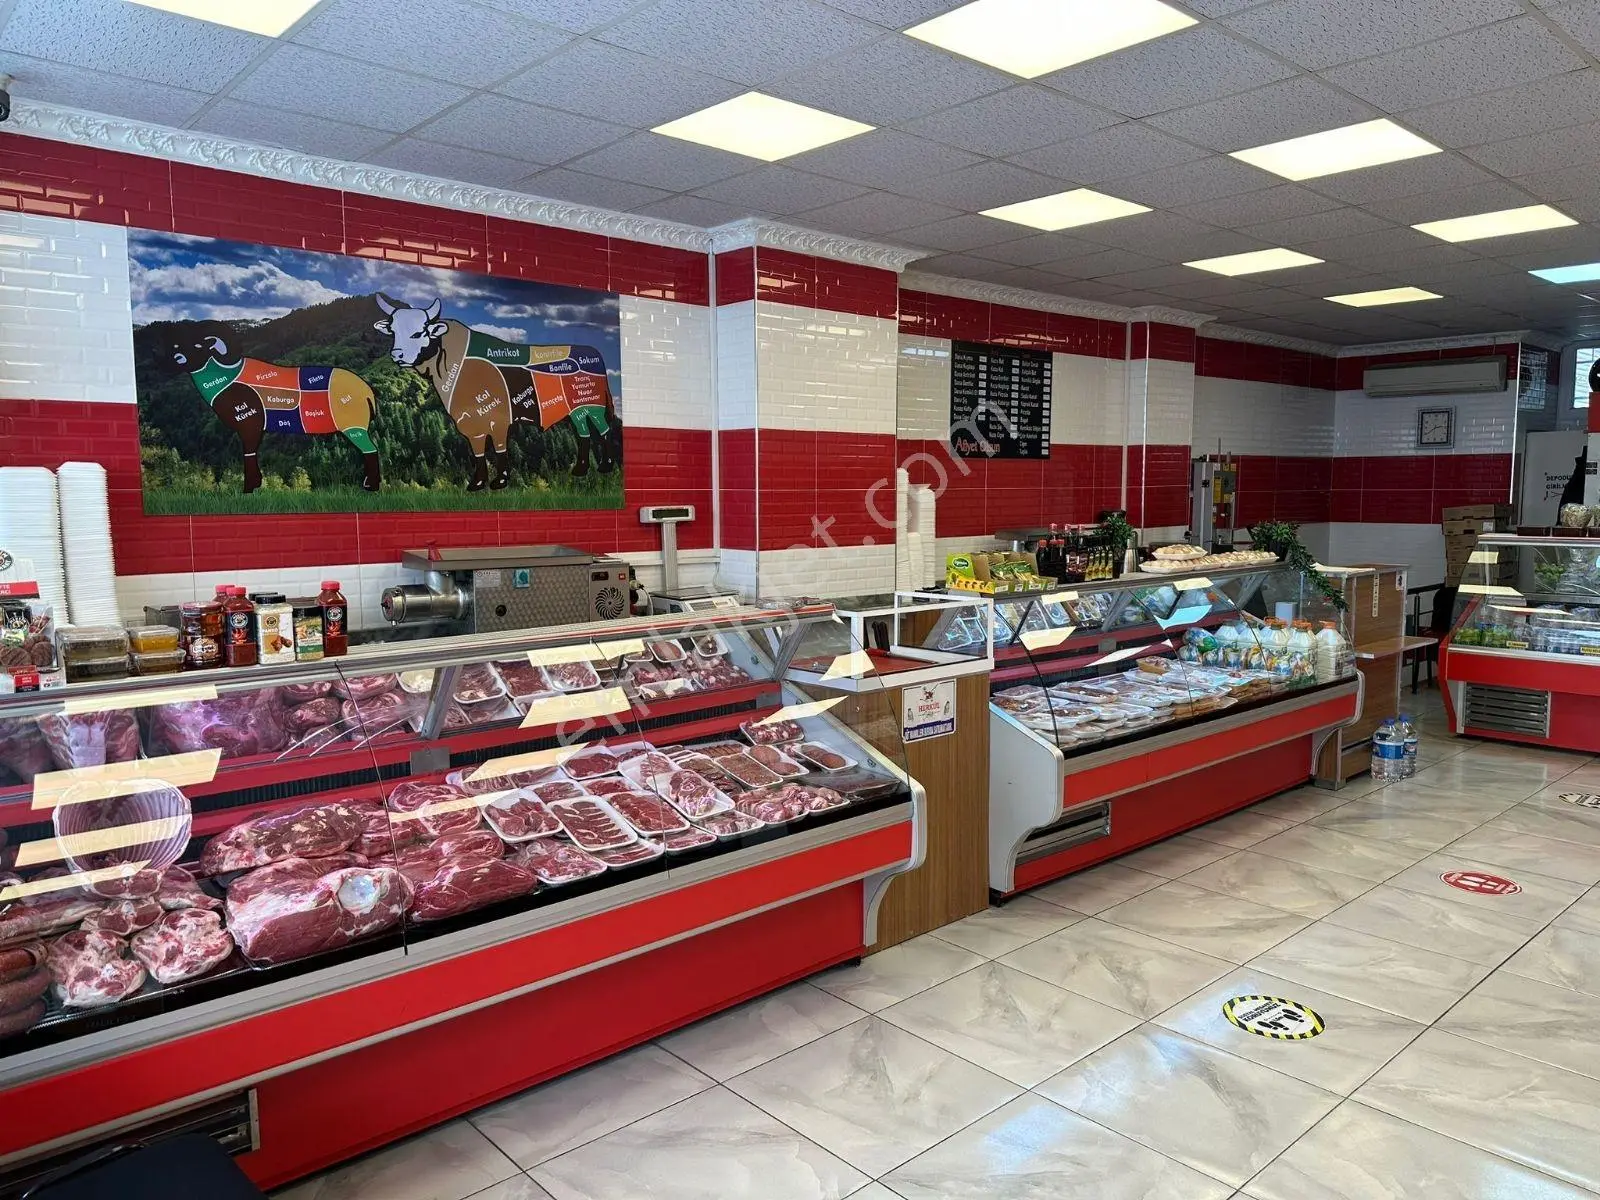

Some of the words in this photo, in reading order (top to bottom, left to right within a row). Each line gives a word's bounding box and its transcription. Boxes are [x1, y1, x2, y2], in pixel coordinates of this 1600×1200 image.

[487, 348, 520, 357] Antrikot
[578, 356, 600, 365] Sokum
[549, 364, 572, 372] Bonfile
[256, 370, 278, 381] Pirzola
[441, 362, 460, 393] Gerdan
[202, 375, 228, 389] Gerdan
[267, 396, 294, 404] Kaburga
[341, 394, 352, 404] But
[475, 389, 490, 403] Kol
[512, 385, 534, 405] Kaburga
[235, 402, 248, 412] Kol
[476, 397, 502, 416] Kürek
[235, 408, 257, 422] Kürek
